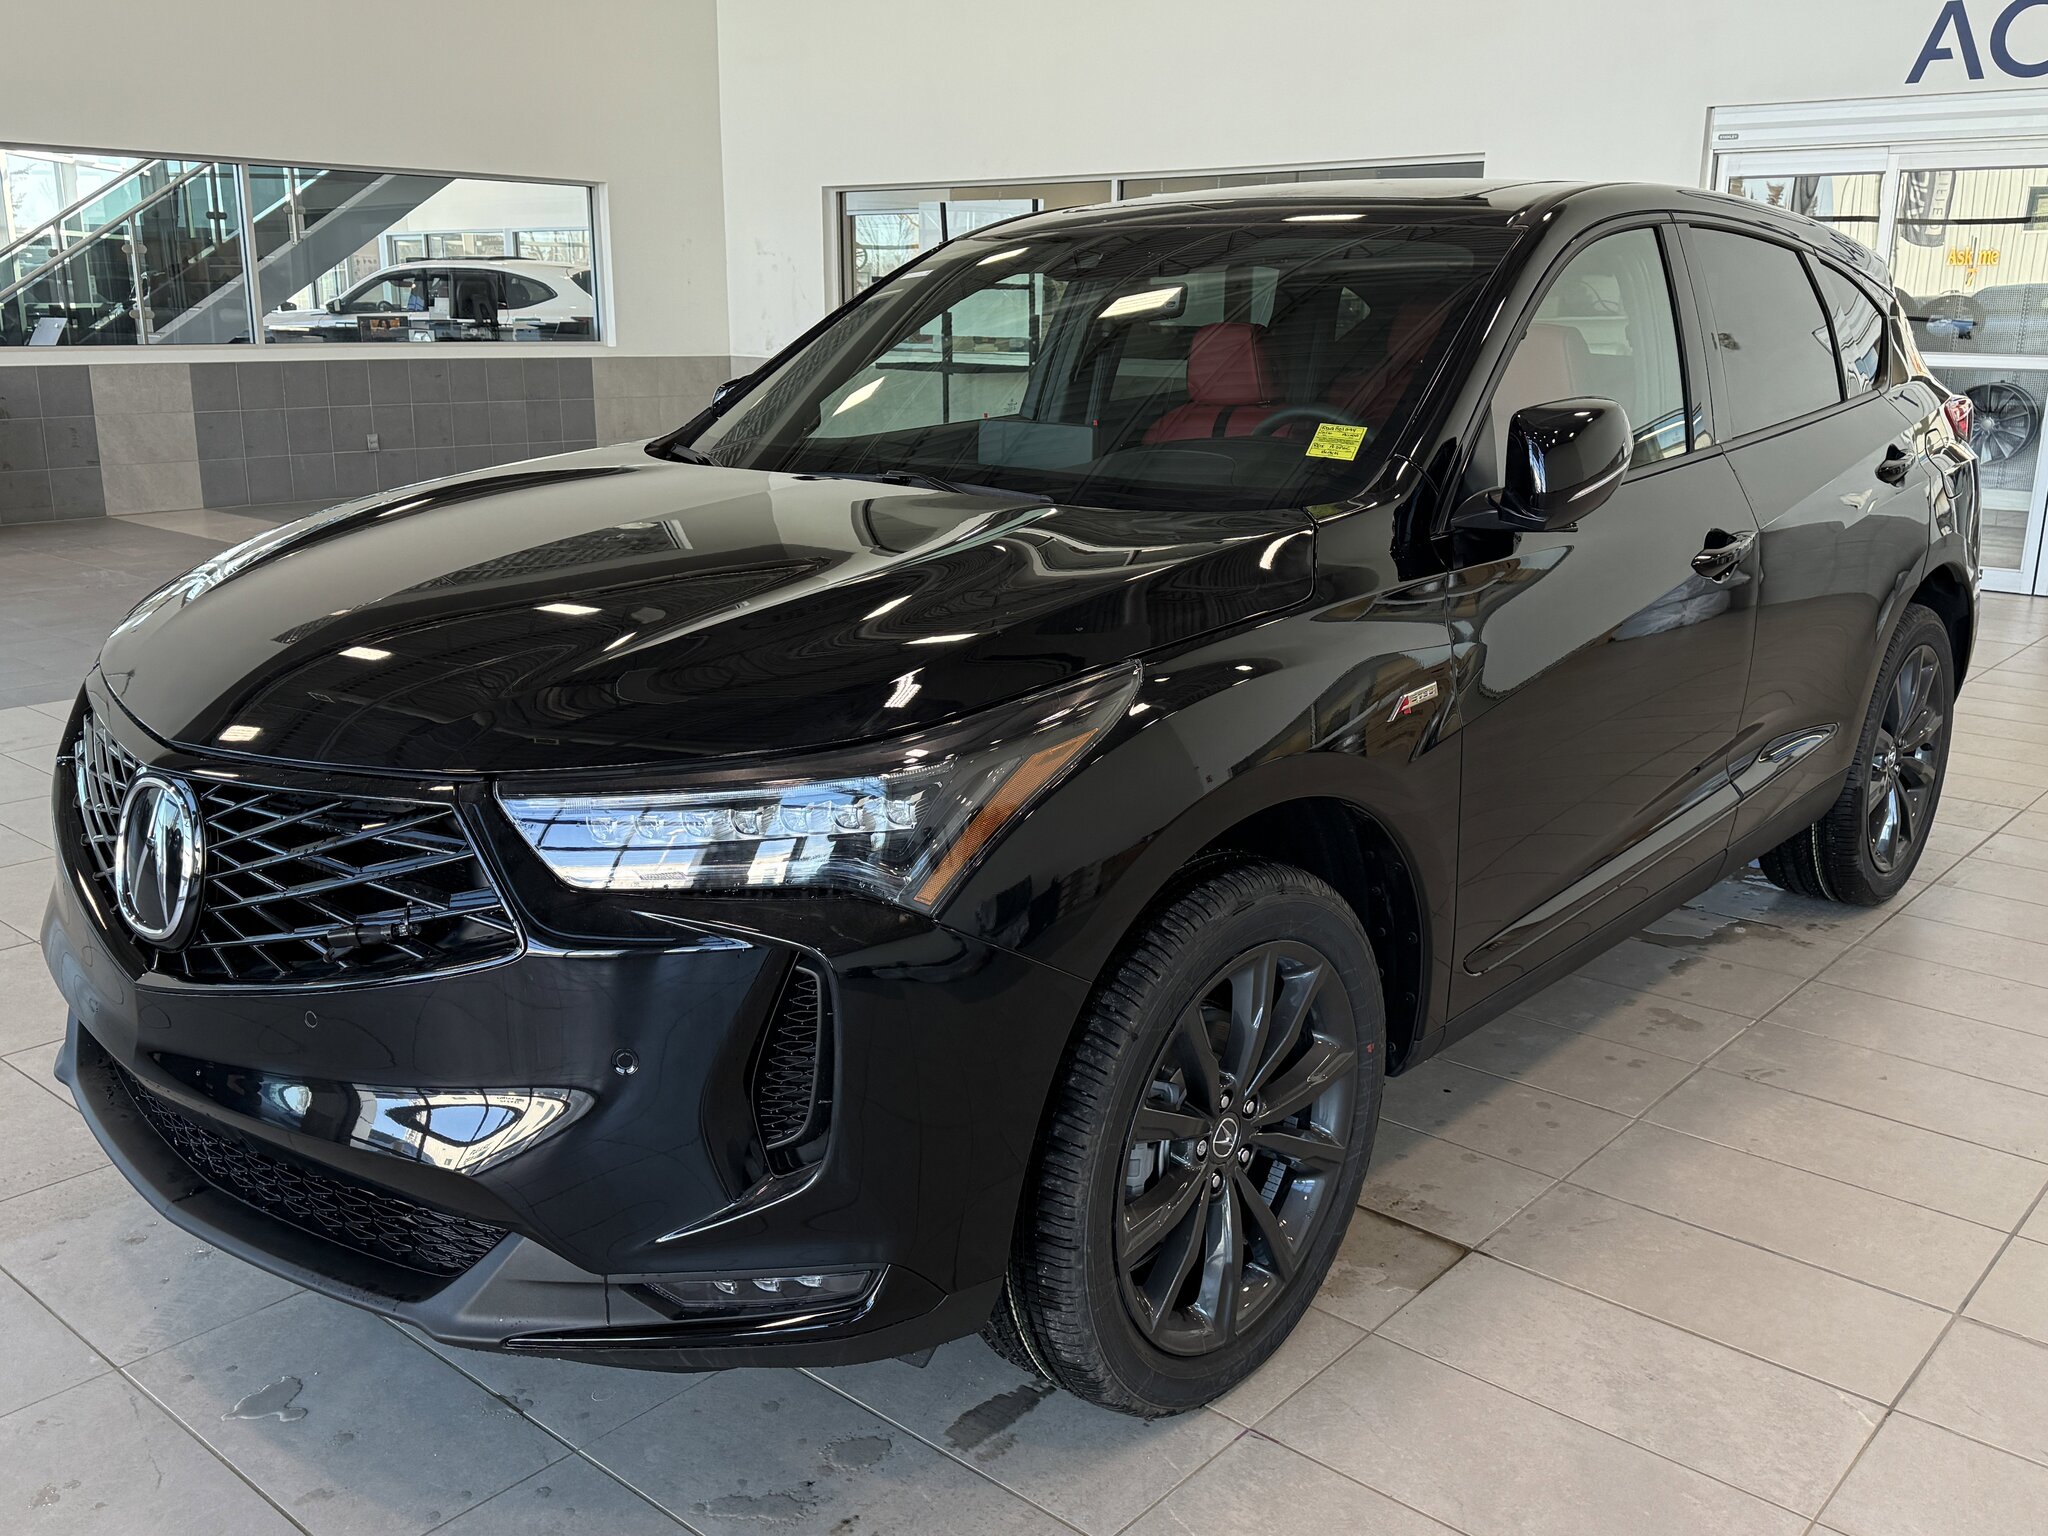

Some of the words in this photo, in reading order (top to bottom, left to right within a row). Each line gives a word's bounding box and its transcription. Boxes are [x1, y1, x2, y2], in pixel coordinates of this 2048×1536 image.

[1904, 0, 2048, 84] AC
[1946, 246, 1973, 266] Ask
[1977, 249, 2001, 266] me
